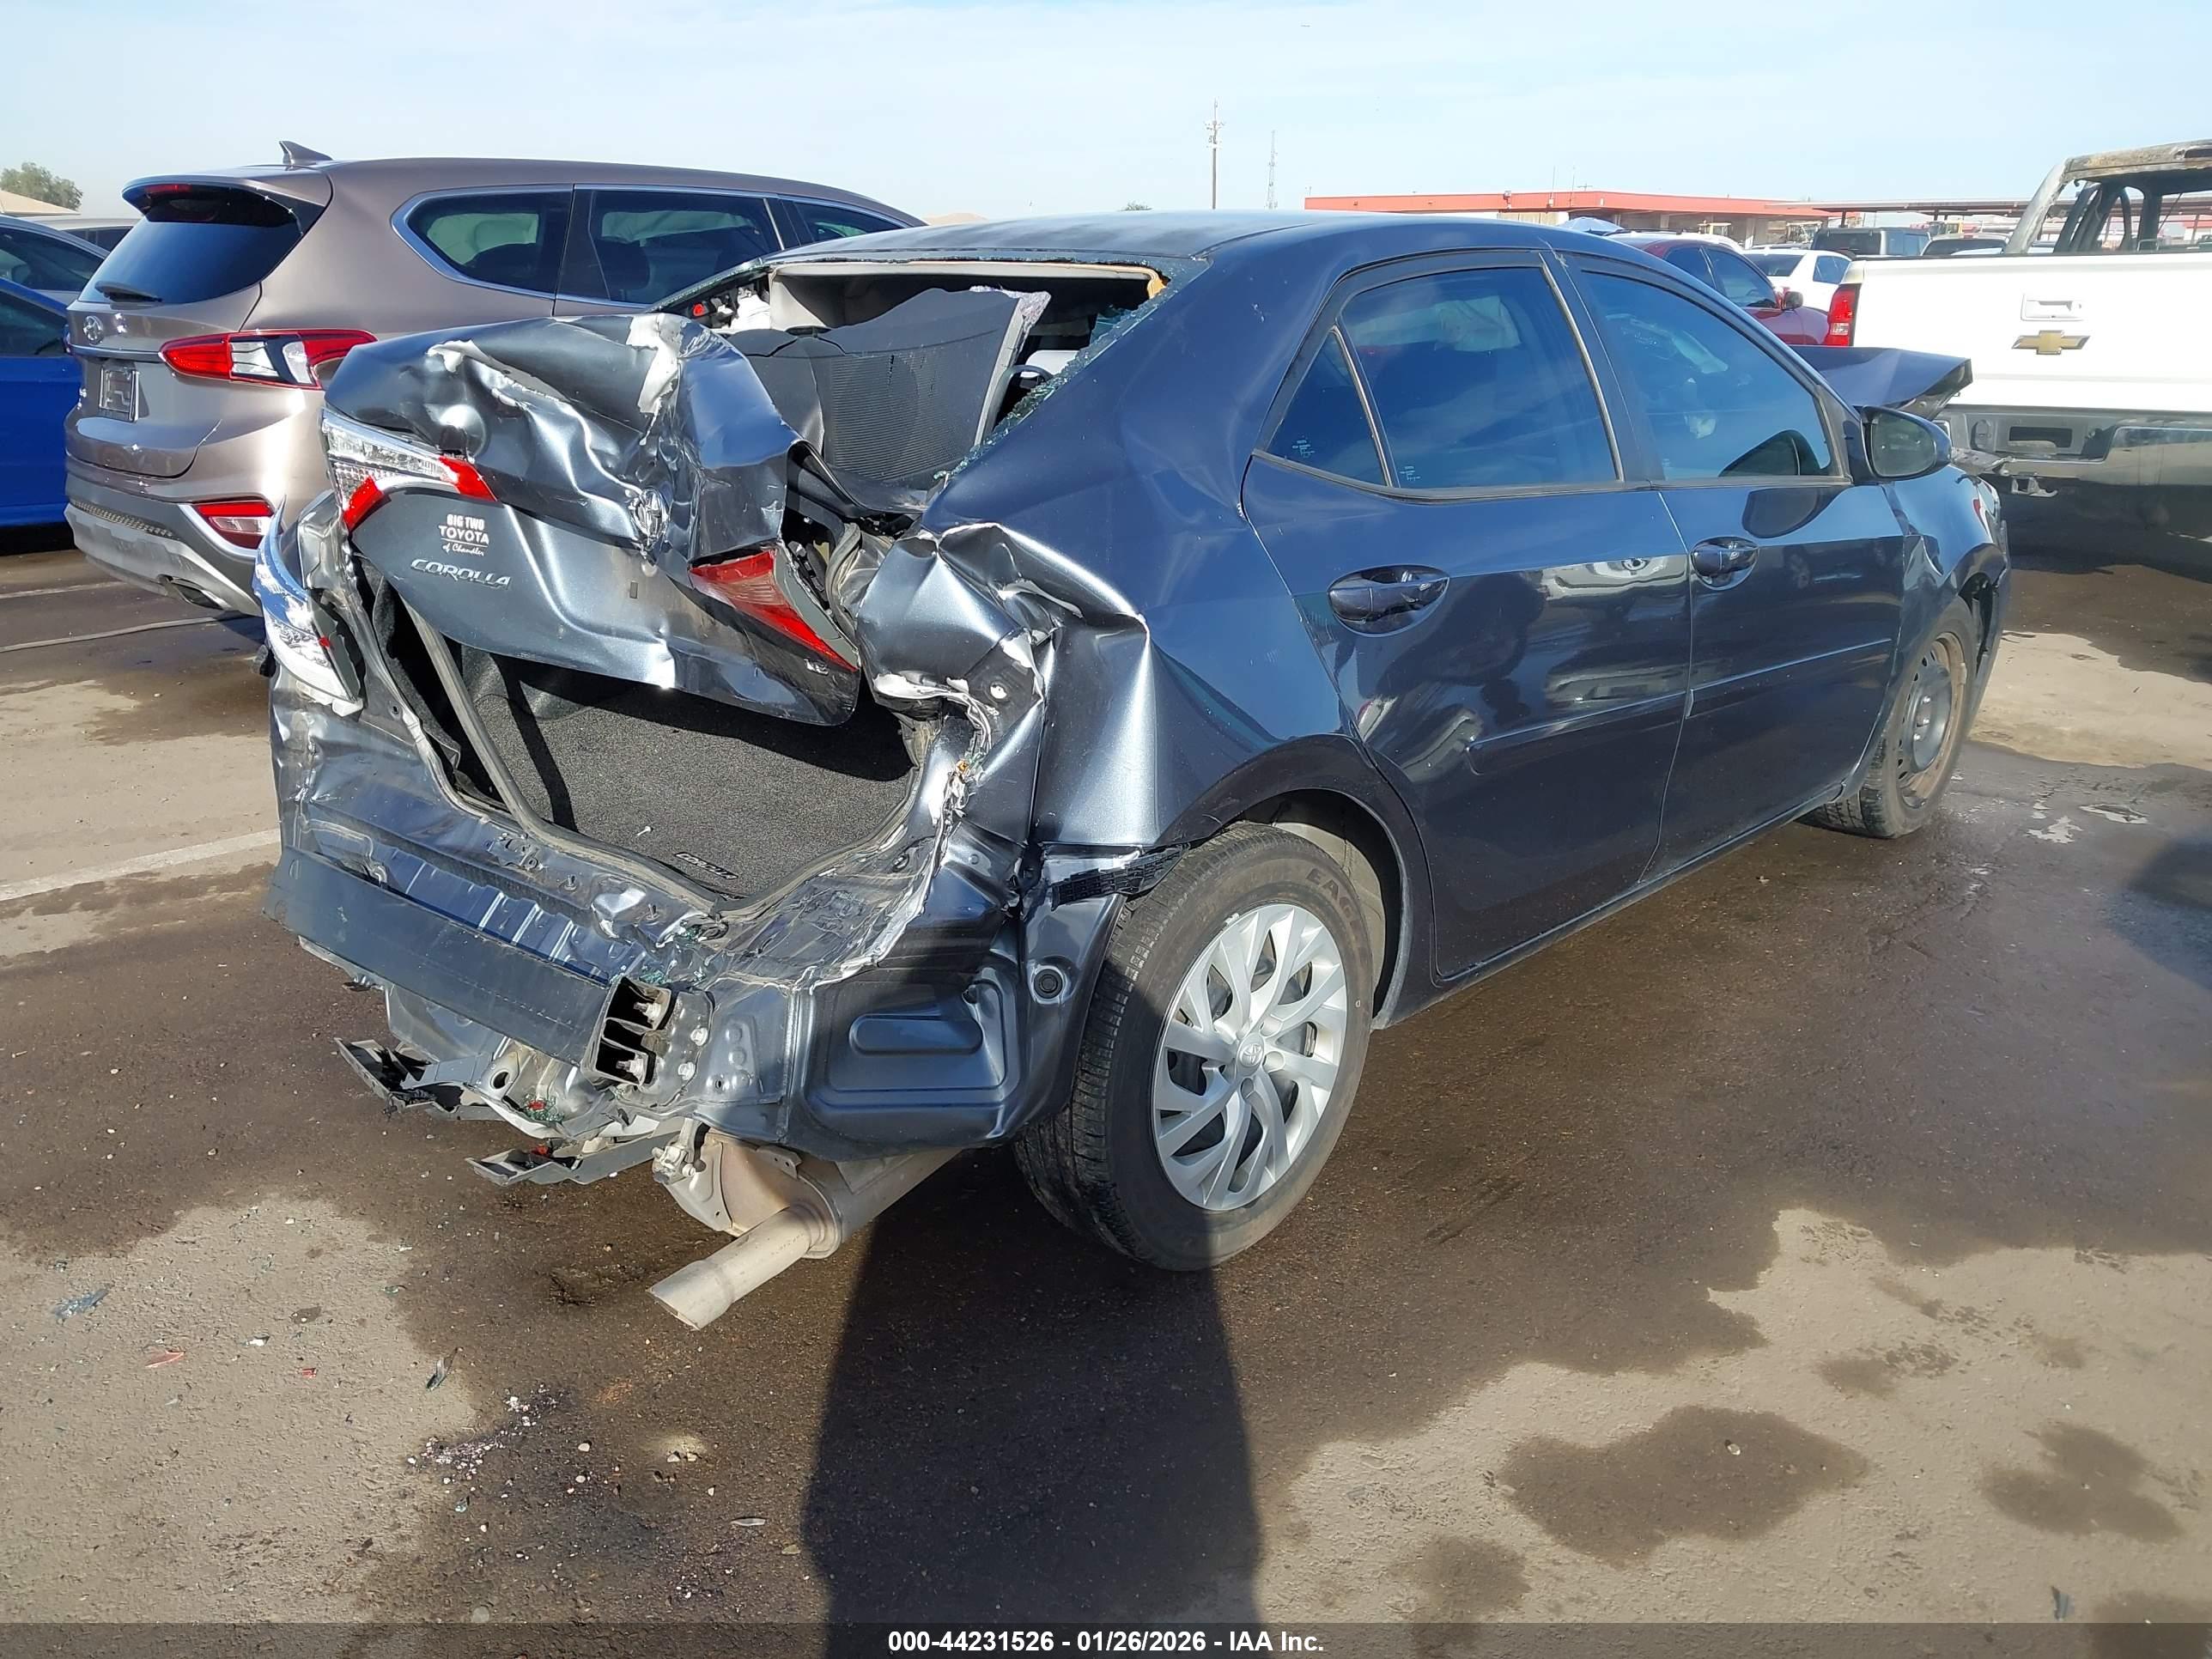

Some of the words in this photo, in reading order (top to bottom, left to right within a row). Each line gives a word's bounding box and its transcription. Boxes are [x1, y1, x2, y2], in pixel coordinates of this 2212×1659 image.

[447, 514, 465, 528] BIG
[465, 516, 485, 532] TWO
[438, 525, 489, 545] TOYOTA
[410, 558, 512, 589] COROLLA
